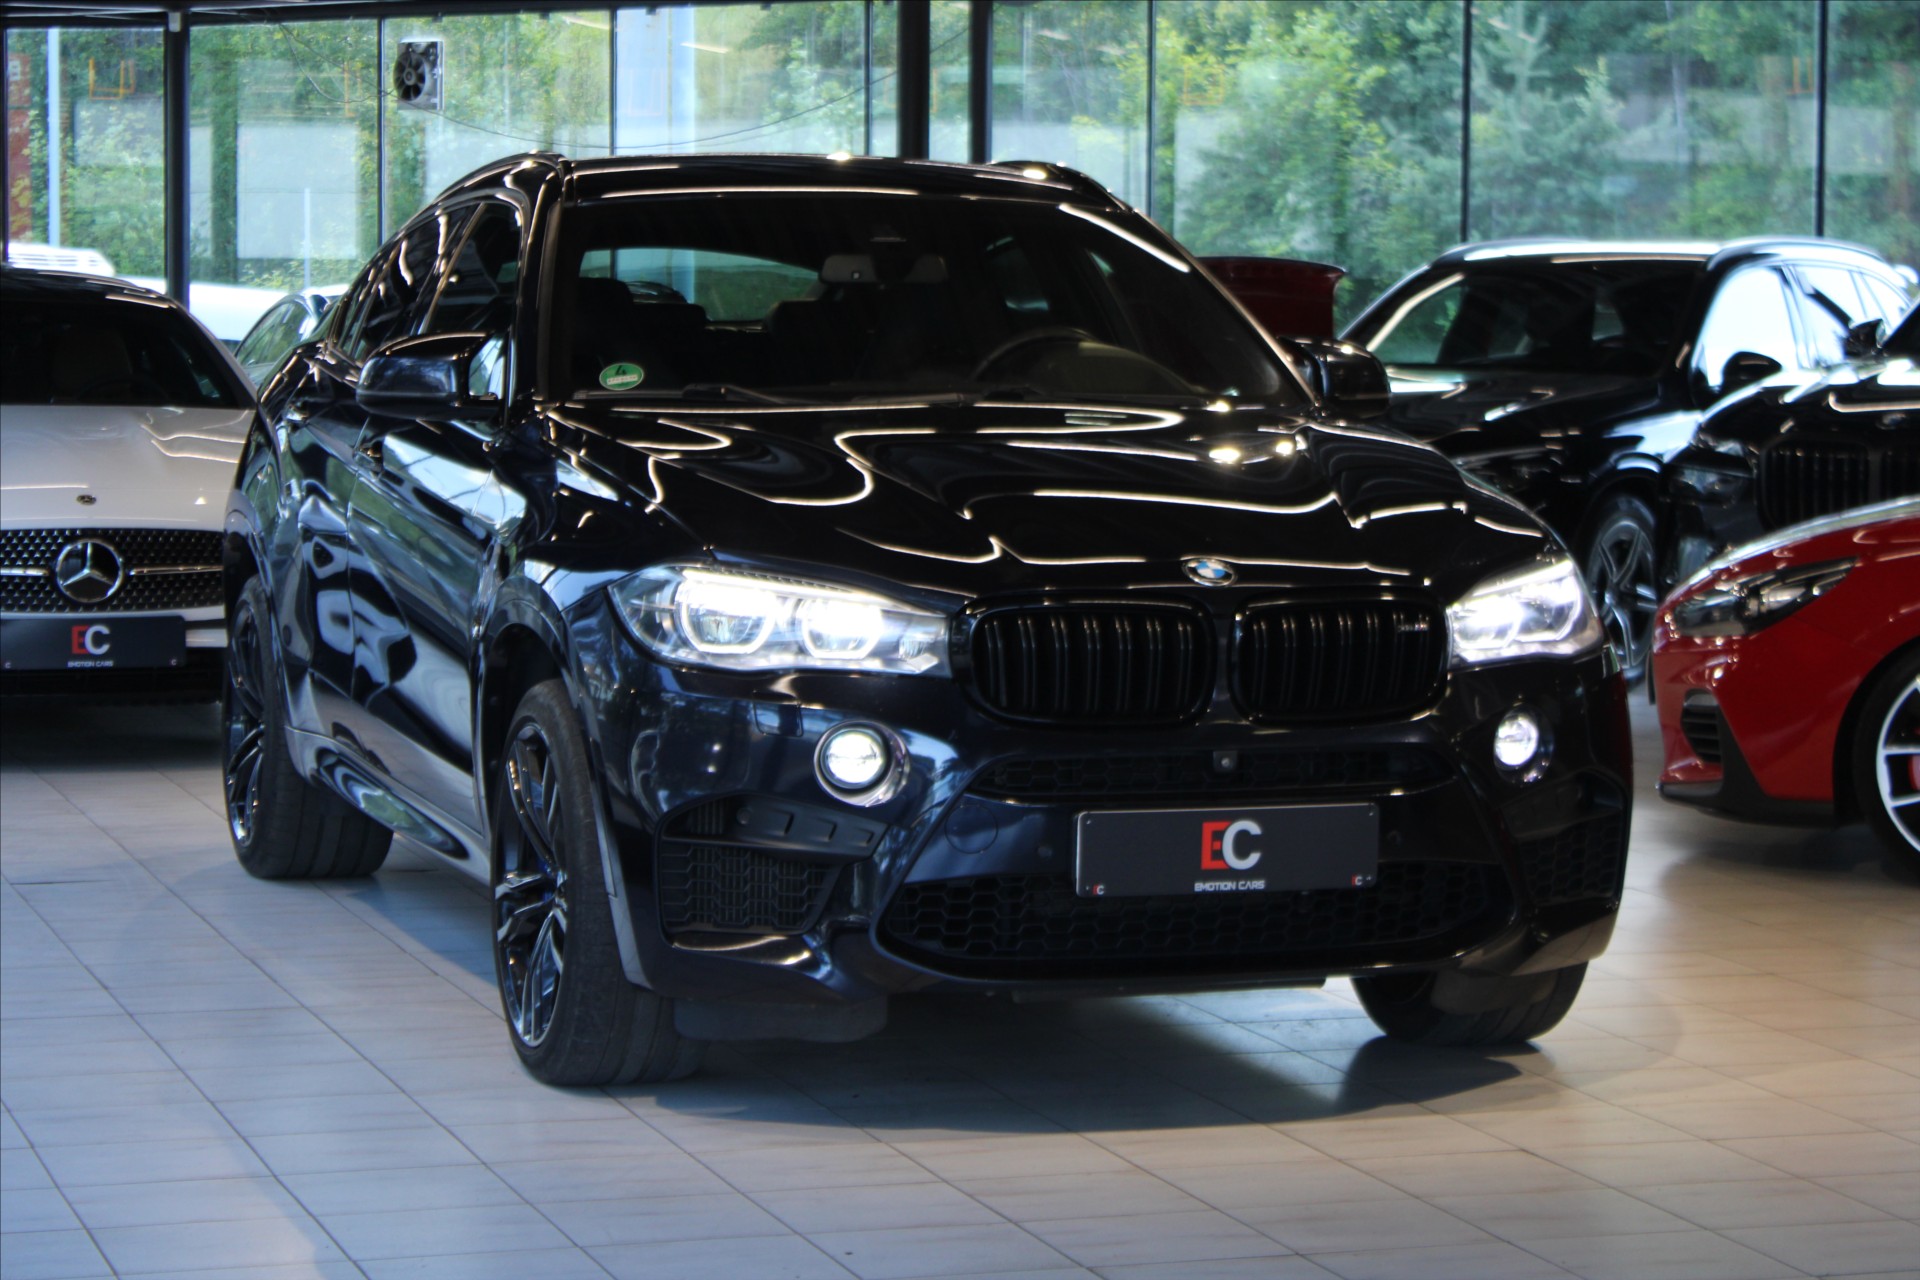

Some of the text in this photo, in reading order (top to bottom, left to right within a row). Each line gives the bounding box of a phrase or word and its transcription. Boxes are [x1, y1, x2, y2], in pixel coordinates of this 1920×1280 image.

[71, 624, 111, 655] EC
[1200, 820, 1262, 870] EC
[1194, 880, 1265, 892] EMOTION CARS
